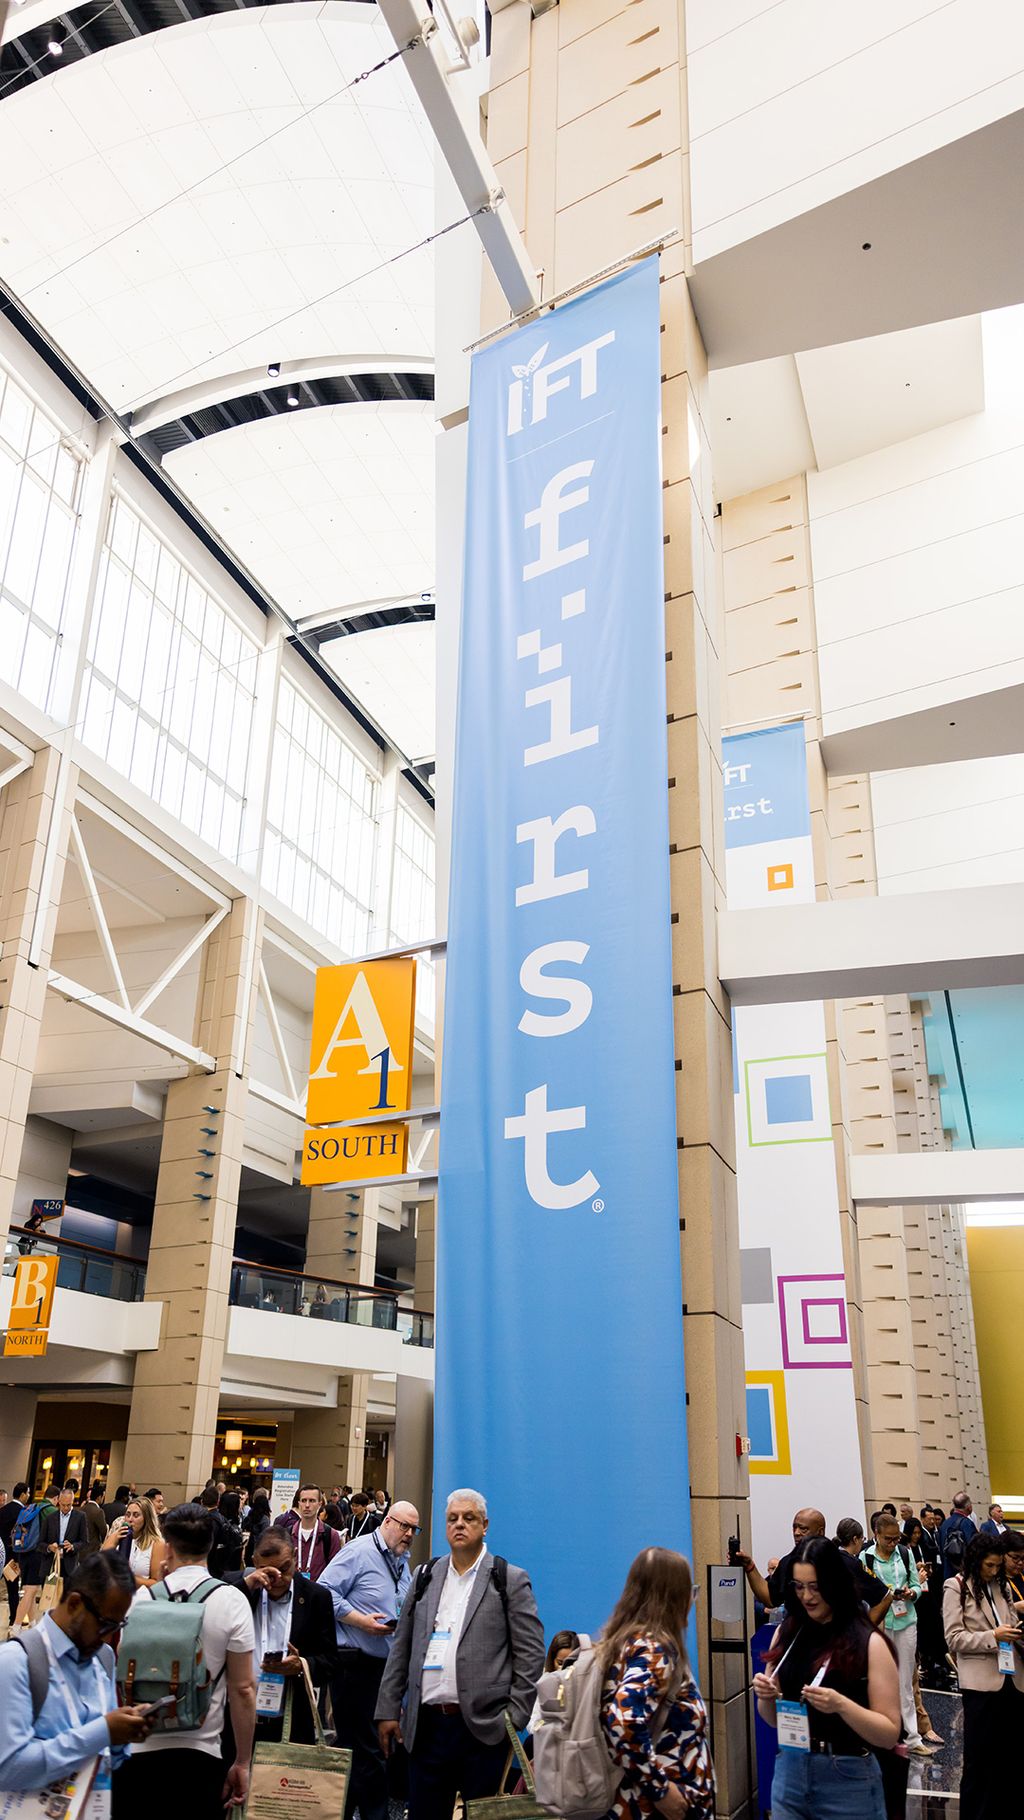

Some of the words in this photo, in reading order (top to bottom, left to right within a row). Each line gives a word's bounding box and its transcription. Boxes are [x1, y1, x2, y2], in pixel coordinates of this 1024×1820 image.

[722, 761, 751, 785] FT
[724, 798, 774, 821] rst
[307, 1133, 399, 1161] SOUTH
[43, 1200, 61, 1210] 426
[7, 1335, 43, 1346] NORTH
